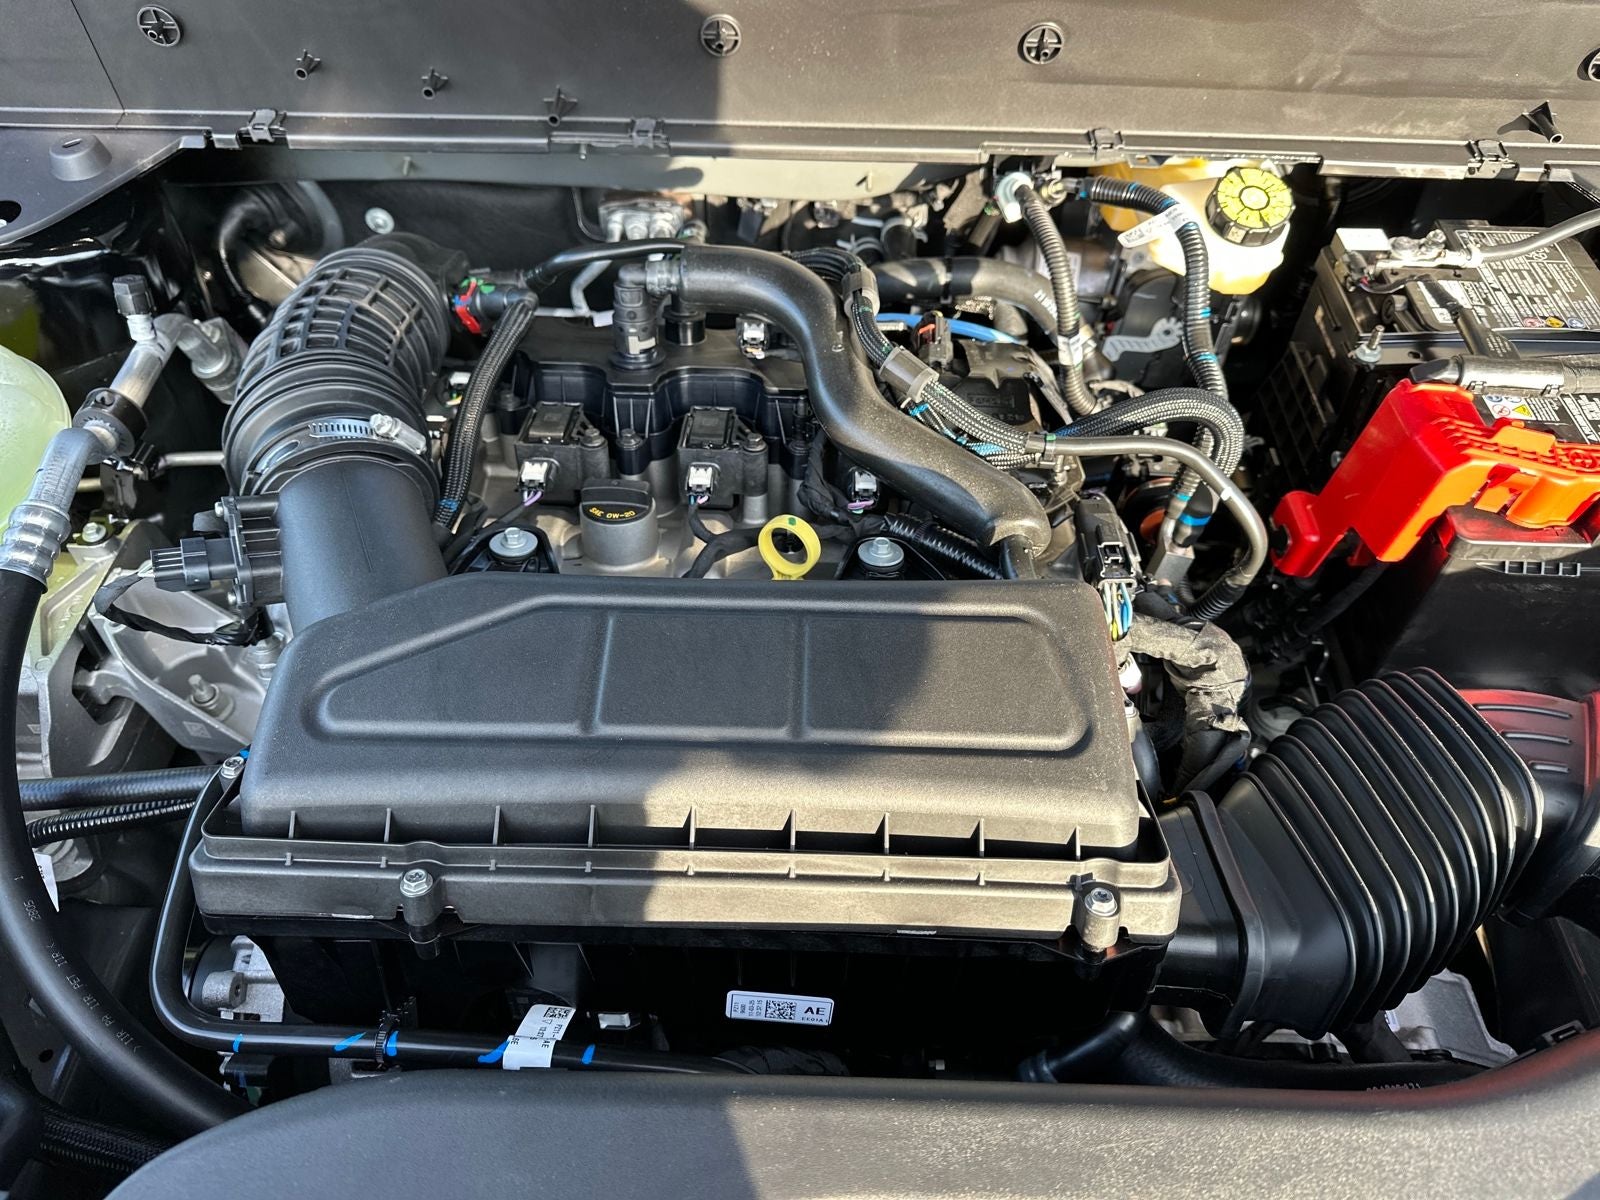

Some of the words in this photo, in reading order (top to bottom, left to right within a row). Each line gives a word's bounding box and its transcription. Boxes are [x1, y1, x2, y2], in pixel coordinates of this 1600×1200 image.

[589, 507, 605, 517] SAE
[66, 974, 83, 990] PET
[804, 1006, 827, 1016] AE
